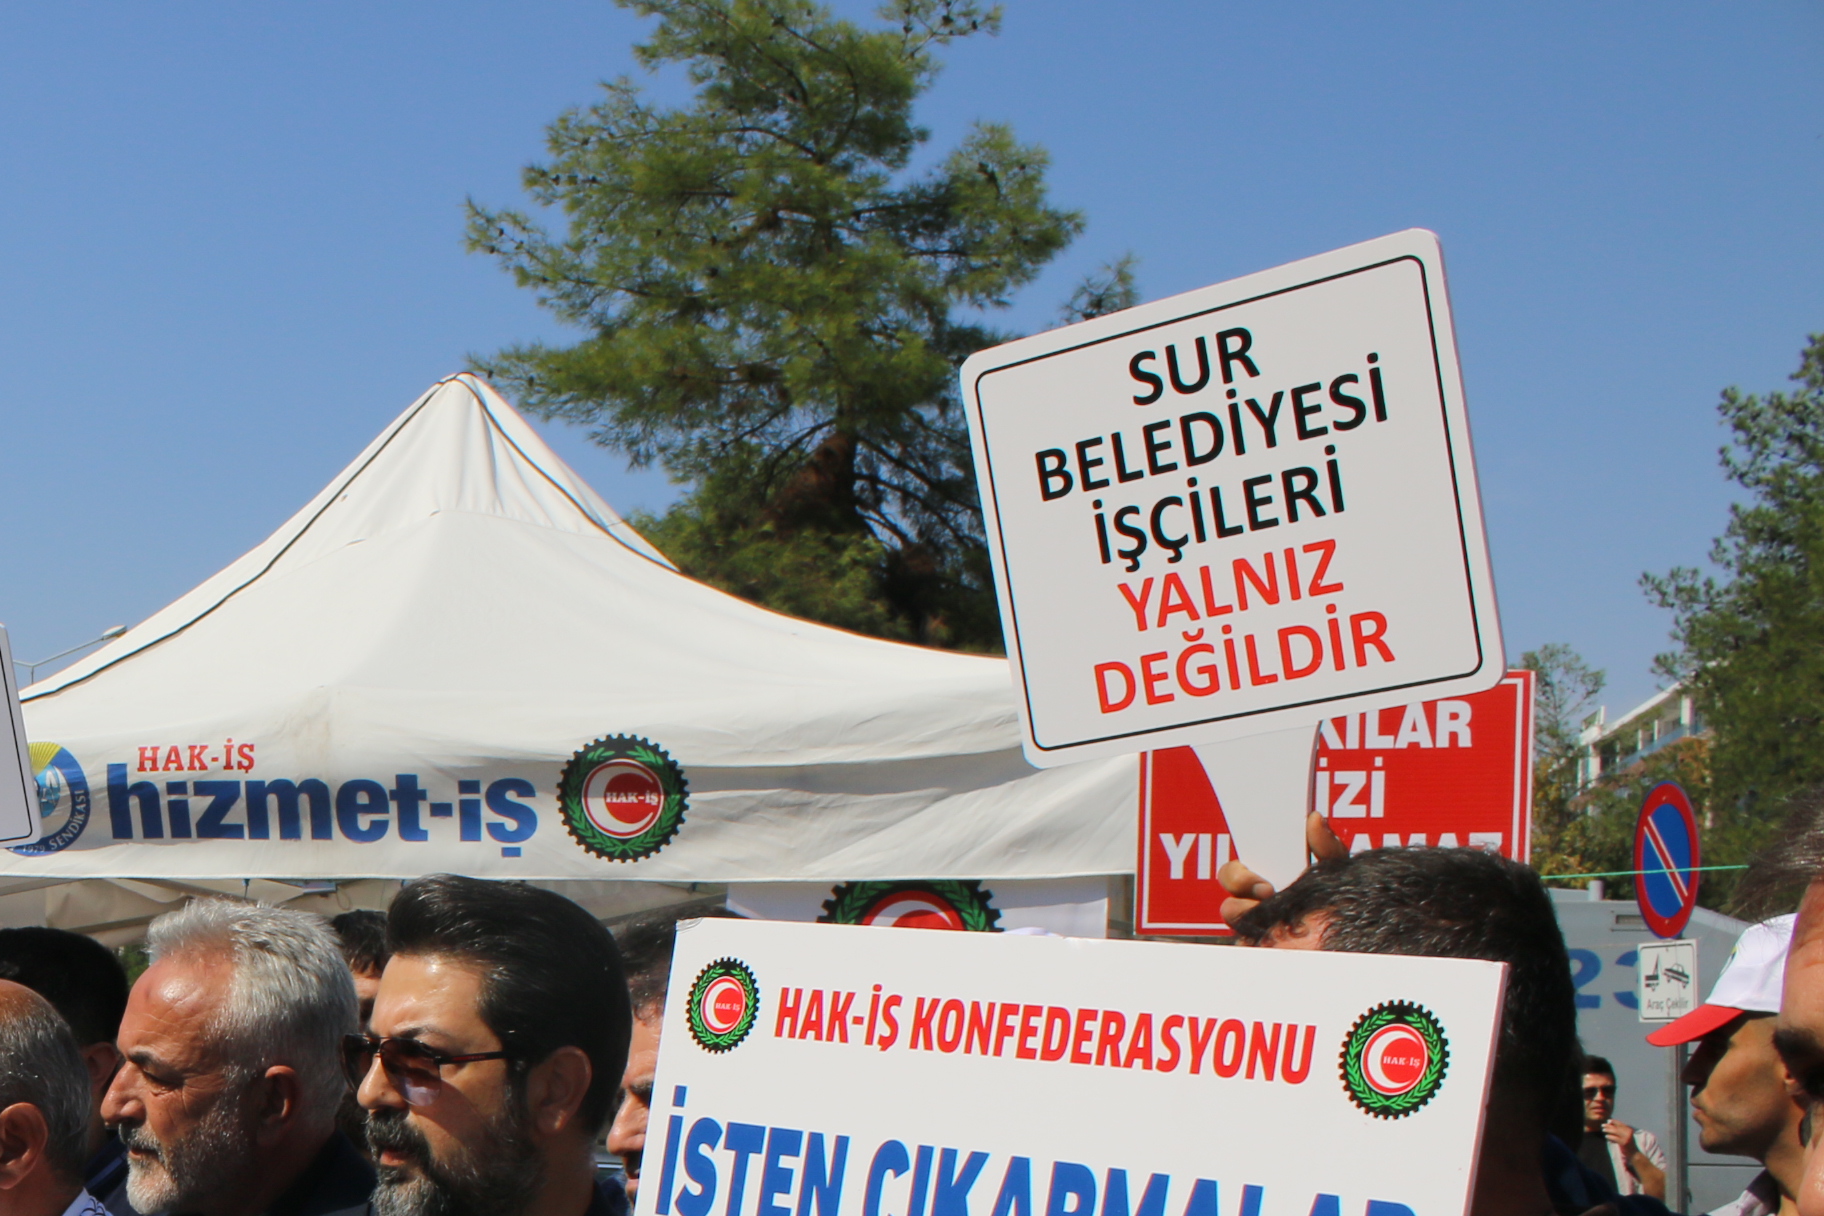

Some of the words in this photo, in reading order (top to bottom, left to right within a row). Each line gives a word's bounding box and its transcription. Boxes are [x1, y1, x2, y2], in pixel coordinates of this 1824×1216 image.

[1129, 327, 1260, 406] SUR
[1035, 352, 1388, 502] BELEDİYESİ
[1092, 445, 1345, 573] İŞÇİLERİ
[1117, 538, 1344, 632] YALNIZ
[1094, 604, 1396, 714] DEĞİLDİR
[137, 737, 255, 773] HAK-İŞ
[606, 790, 659, 806] HAK-İŞ
[49, 790, 87, 850] SENDİKASI
[107, 763, 537, 857] hizmet-iş
[775, 984, 903, 1051] HAK-İŞ
[909, 996, 1316, 1085] KONFEDERASYONU
